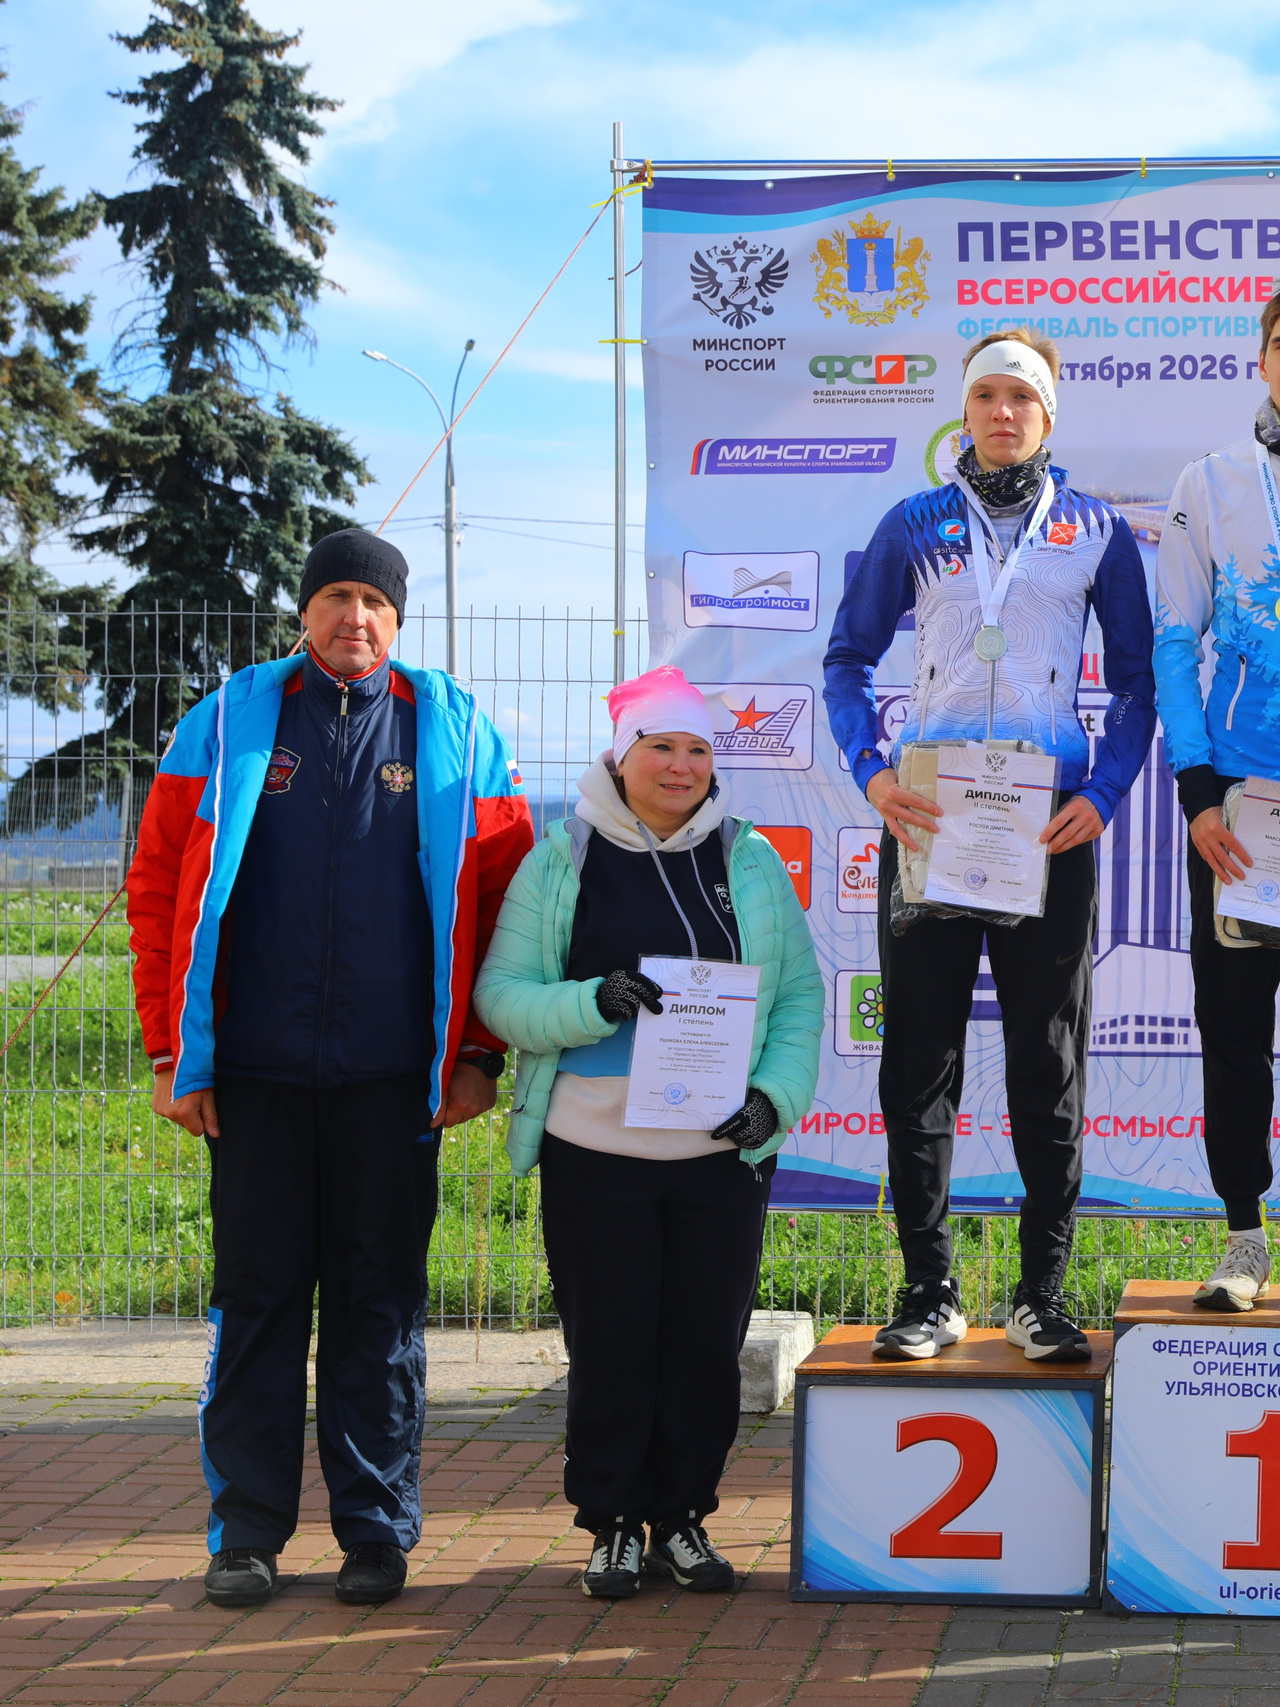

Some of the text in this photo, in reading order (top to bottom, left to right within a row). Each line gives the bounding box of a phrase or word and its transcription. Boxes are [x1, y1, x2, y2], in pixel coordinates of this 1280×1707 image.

[957, 270, 1274, 305] ВСЕРОССИЙСКИЕ
[1125, 314, 1262, 338] СПОРТИВН
[692, 337, 786, 351] МИНСПОРТ
[704, 358, 776, 371] РОССИИ
[1159, 354, 1238, 380] 2026
[812, 388, 935, 397] ФЕДЕРАЦИЯ СПОРТИВНОГО
[897, 396, 935, 404] РОССИИ
[1030, 370, 1056, 417] TERREX
[717, 444, 888, 461] МИНСПОРТ
[1262, 462, 1276, 505] МИНИСТЕРСТВО
[1271, 505, 1280, 528] СПОРТА
[713, 732, 784, 750] офавиа
[965, 789, 1021, 804] ДИПЛОМ
[980, 804, 1011, 813] степень
[669, 1003, 726, 1016] ДИПЛОМ
[682, 1018, 714, 1026] степень
[1151, 1338, 1267, 1358] ФЕДЕРАЦИЯ
[889, 1411, 1003, 1560] 2
